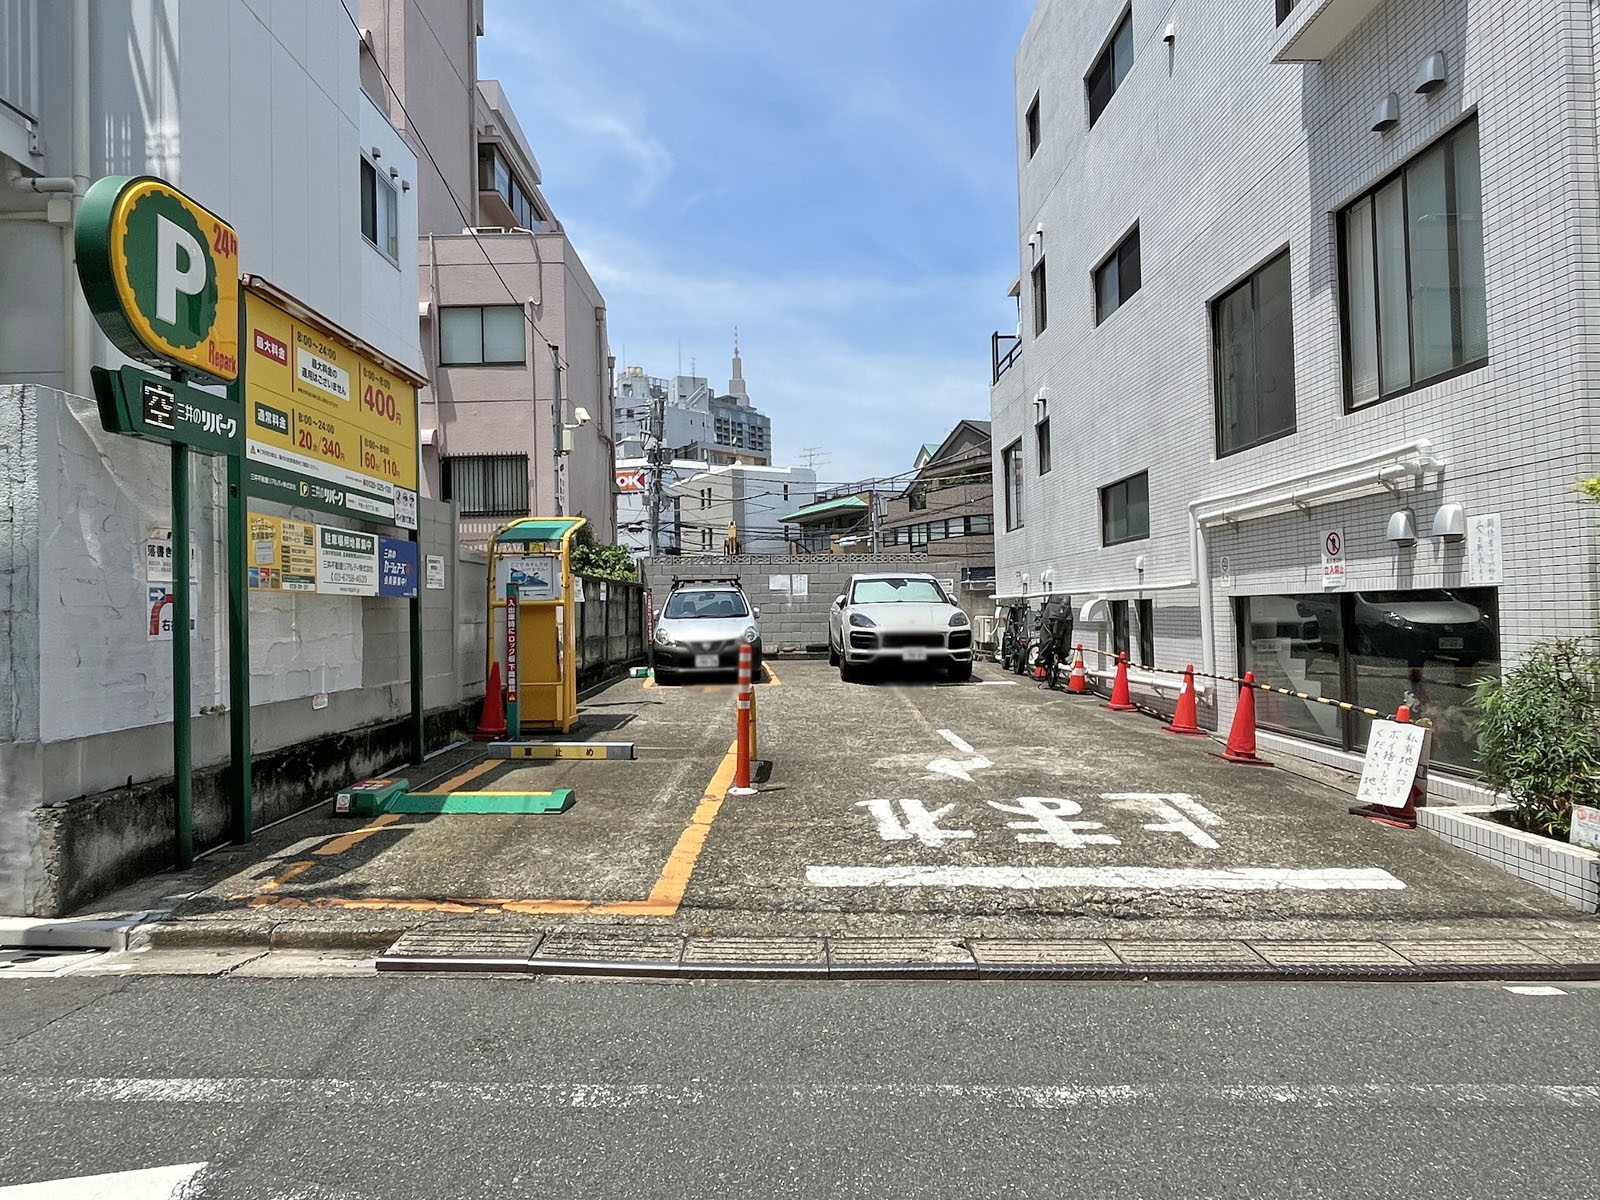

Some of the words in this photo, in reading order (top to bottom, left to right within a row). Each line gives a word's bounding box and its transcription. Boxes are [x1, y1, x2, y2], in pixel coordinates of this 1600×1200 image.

[213, 223, 238, 259] 24h
[155, 213, 207, 326] P
[209, 340, 237, 374] Repark
[256, 335, 286, 360] 最大料金
[144, 385, 175, 430] 空
[177, 402, 237, 438] 三井のリパーク
[257, 408, 287, 430] 通常料金
[364, 384, 402, 425] 400円
[311, 484, 344, 506] 三井のリパーク
[616, 469, 646, 489] OK
[1324, 565, 1345, 576] 立入禁止
